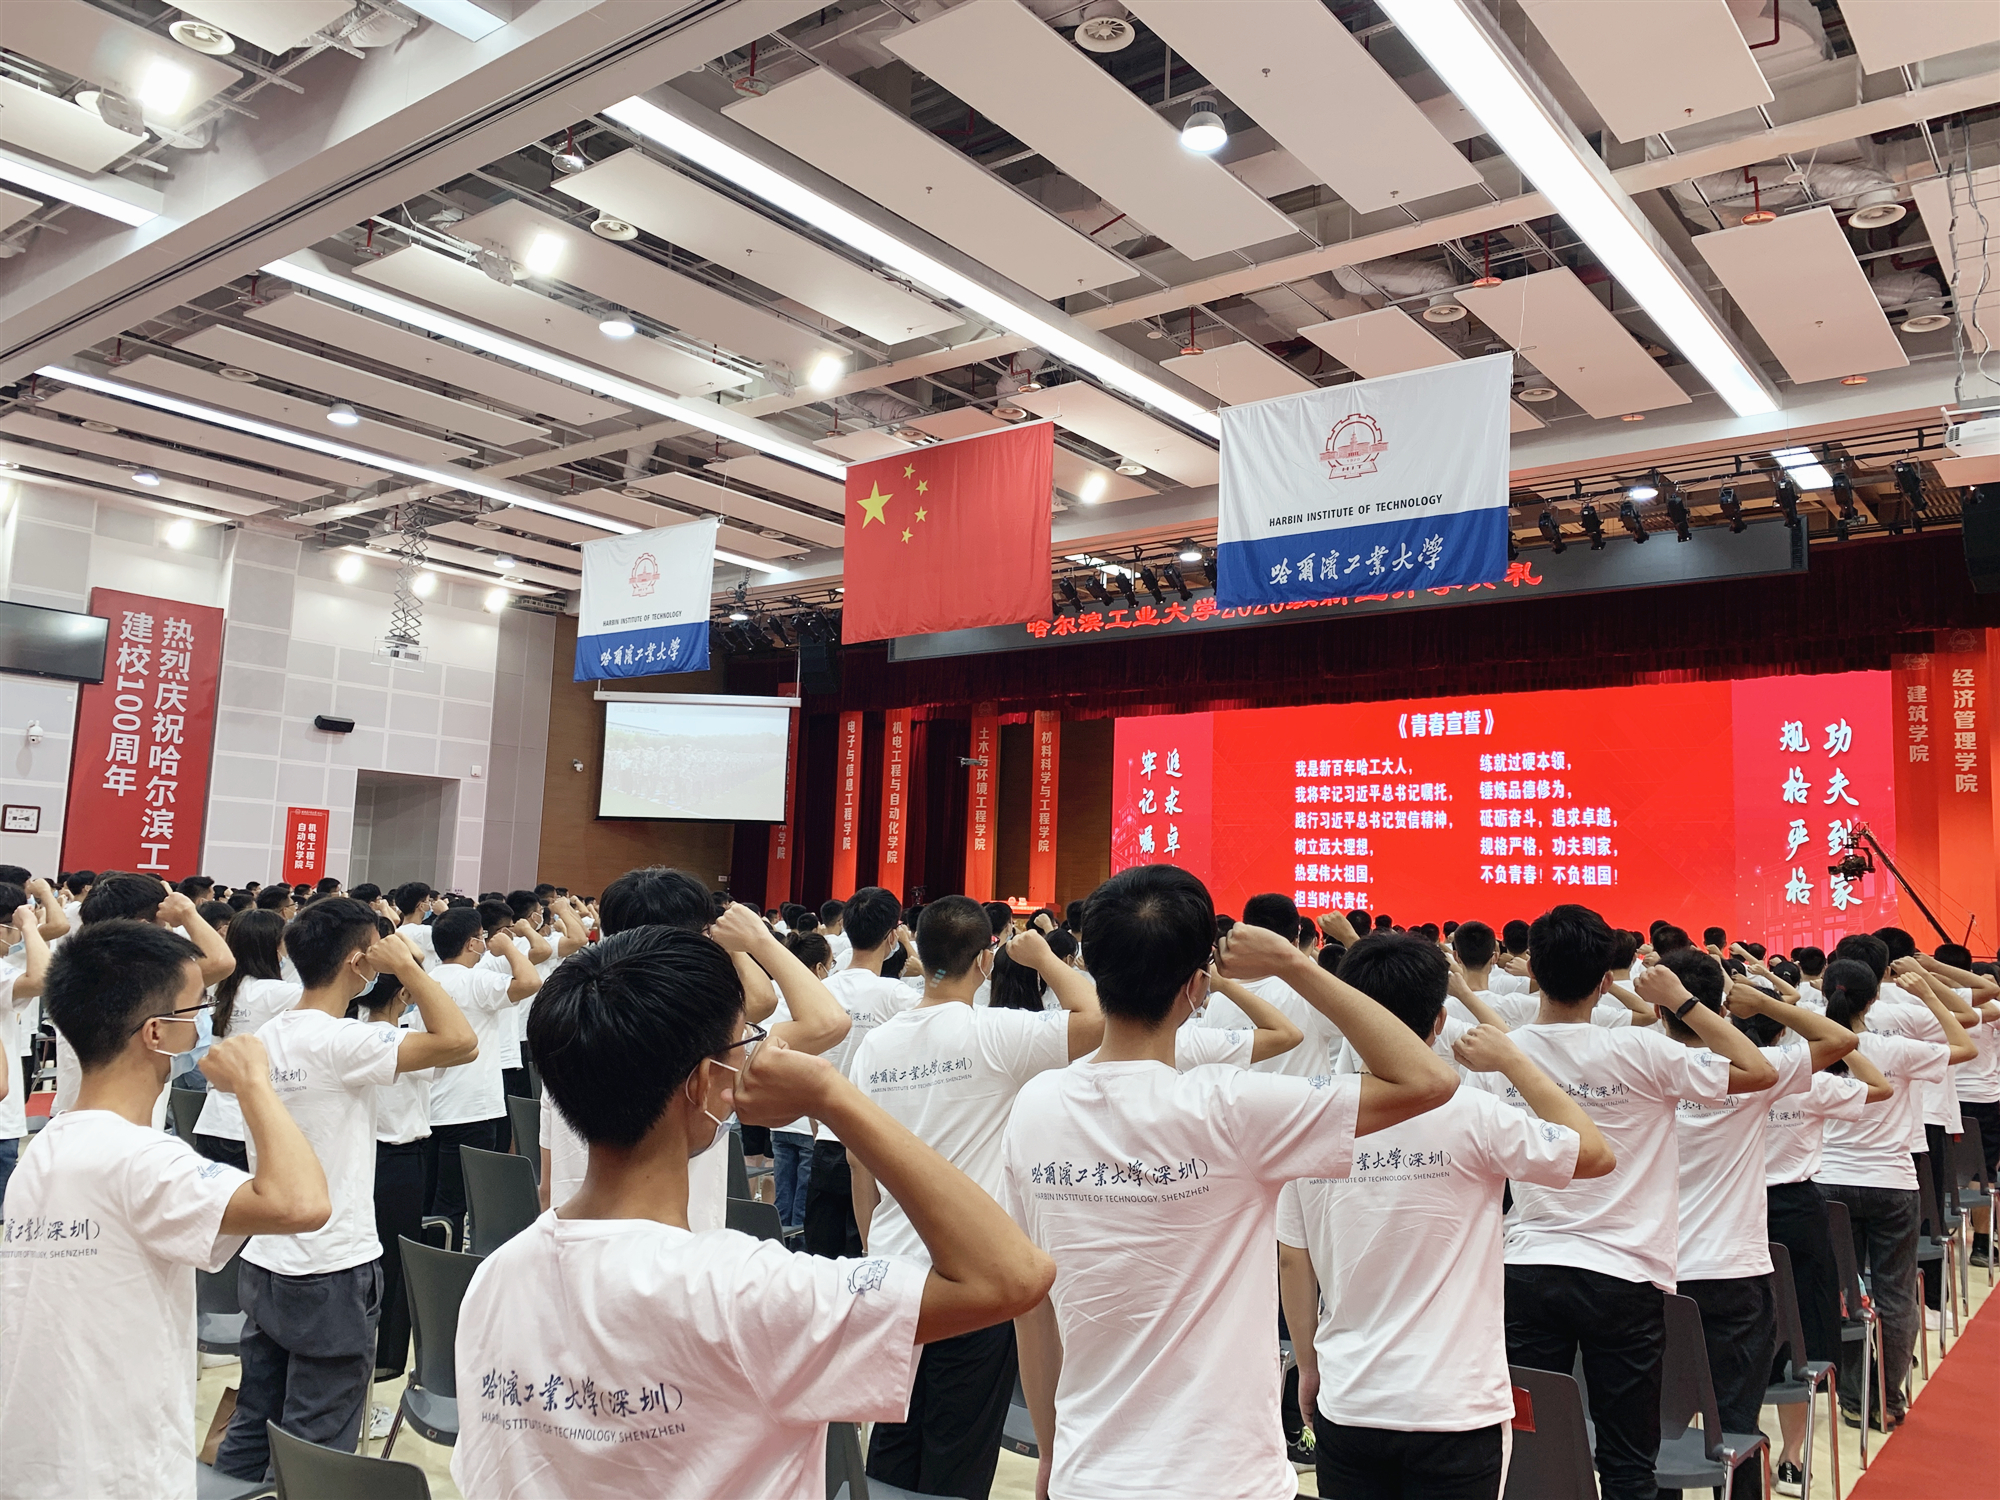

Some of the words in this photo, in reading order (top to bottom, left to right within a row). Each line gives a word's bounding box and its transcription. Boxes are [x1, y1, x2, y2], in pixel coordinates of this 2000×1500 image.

[1341, 464, 1363, 472] HIT
[1269, 514, 1303, 528] HARBIN
[1306, 506, 1354, 522] INSTITUTE
[1358, 504, 1371, 515] OF
[1376, 494, 1443, 513] TECHNOLOGY
[602, 618, 619, 627] HARBIN
[620, 615, 643, 625] INSTITUTE
[643, 614, 651, 622] OF
[651, 610, 682, 621] TECHNOLOGY
[102, 610, 155, 797] 建校100周年
[1398, 709, 1494, 739] 《青春宣誓》
[1906, 685, 1930, 763] 建筑学院
[1952, 668, 1979, 793] 经济管理学院
[136, 616, 195, 871] 热烈庆祝哈尔滨工
[1294, 757, 1413, 778] 我是新百年哈工大人，
[1479, 751, 1572, 773] 练就过硬本领，
[842, 720, 856, 851] 电子与信息工程学院
[886, 721, 903, 864] 机电工程与自动化学院
[974, 727, 990, 851] 土木与环境工程学院
[1037, 731, 1053, 853] 材料科学与工程学院
[1294, 782, 1453, 803] 我将牢记习近平总书记嘱托，
[1479, 780, 1572, 800] 锤炼品德修为，
[1163, 747, 1183, 858] 追求卓
[1779, 719, 1815, 905] 规格严格
[1823, 718, 1863, 912] 功夫到家
[1294, 810, 1453, 830] 践行习近平总书记贺信精神，
[294, 822, 307, 870] 自动化学院
[304, 822, 317, 870] 机电工程与
[1294, 838, 1374, 857] 树立远大理想，
[1294, 864, 1374, 884] 热爱伟大祖国，
[1294, 890, 1374, 910] 担当时代责任，
[1413, 1171, 1450, 1180] SHENZHEN
[1034, 1192, 1055, 1201] HARBIN
[1055, 1193, 1093, 1202] INSTITUTE
[1093, 1194, 1104, 1202] OF
[1105, 1194, 1161, 1204] TECHNOLOGY,
[1162, 1184, 1210, 1203] SHENZHEN
[49, 1248, 98, 1259] SHENZHEN
[481, 1367, 683, 1418] 哈濱工業大學(深圳)
[618, 1422, 686, 1443] SHENZHEN
